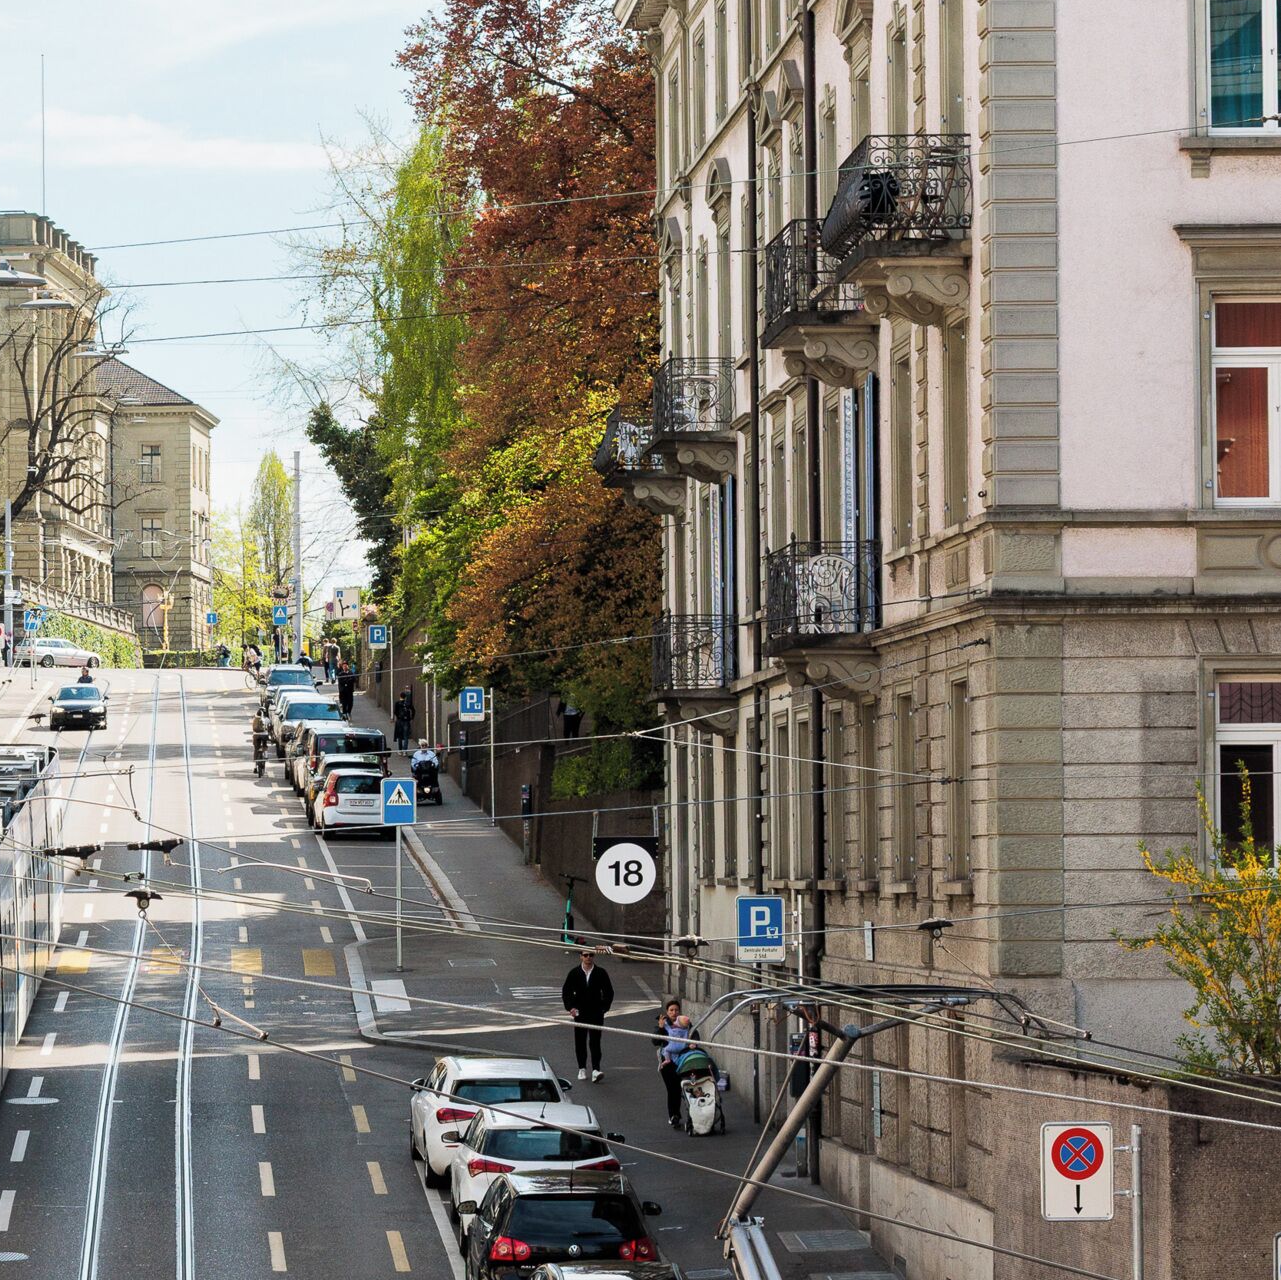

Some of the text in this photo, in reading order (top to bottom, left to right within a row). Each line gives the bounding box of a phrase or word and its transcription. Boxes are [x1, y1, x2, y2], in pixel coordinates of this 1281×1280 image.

[466, 692, 478, 709] P
[608, 860, 643, 887] 18
[750, 906, 771, 938] P
